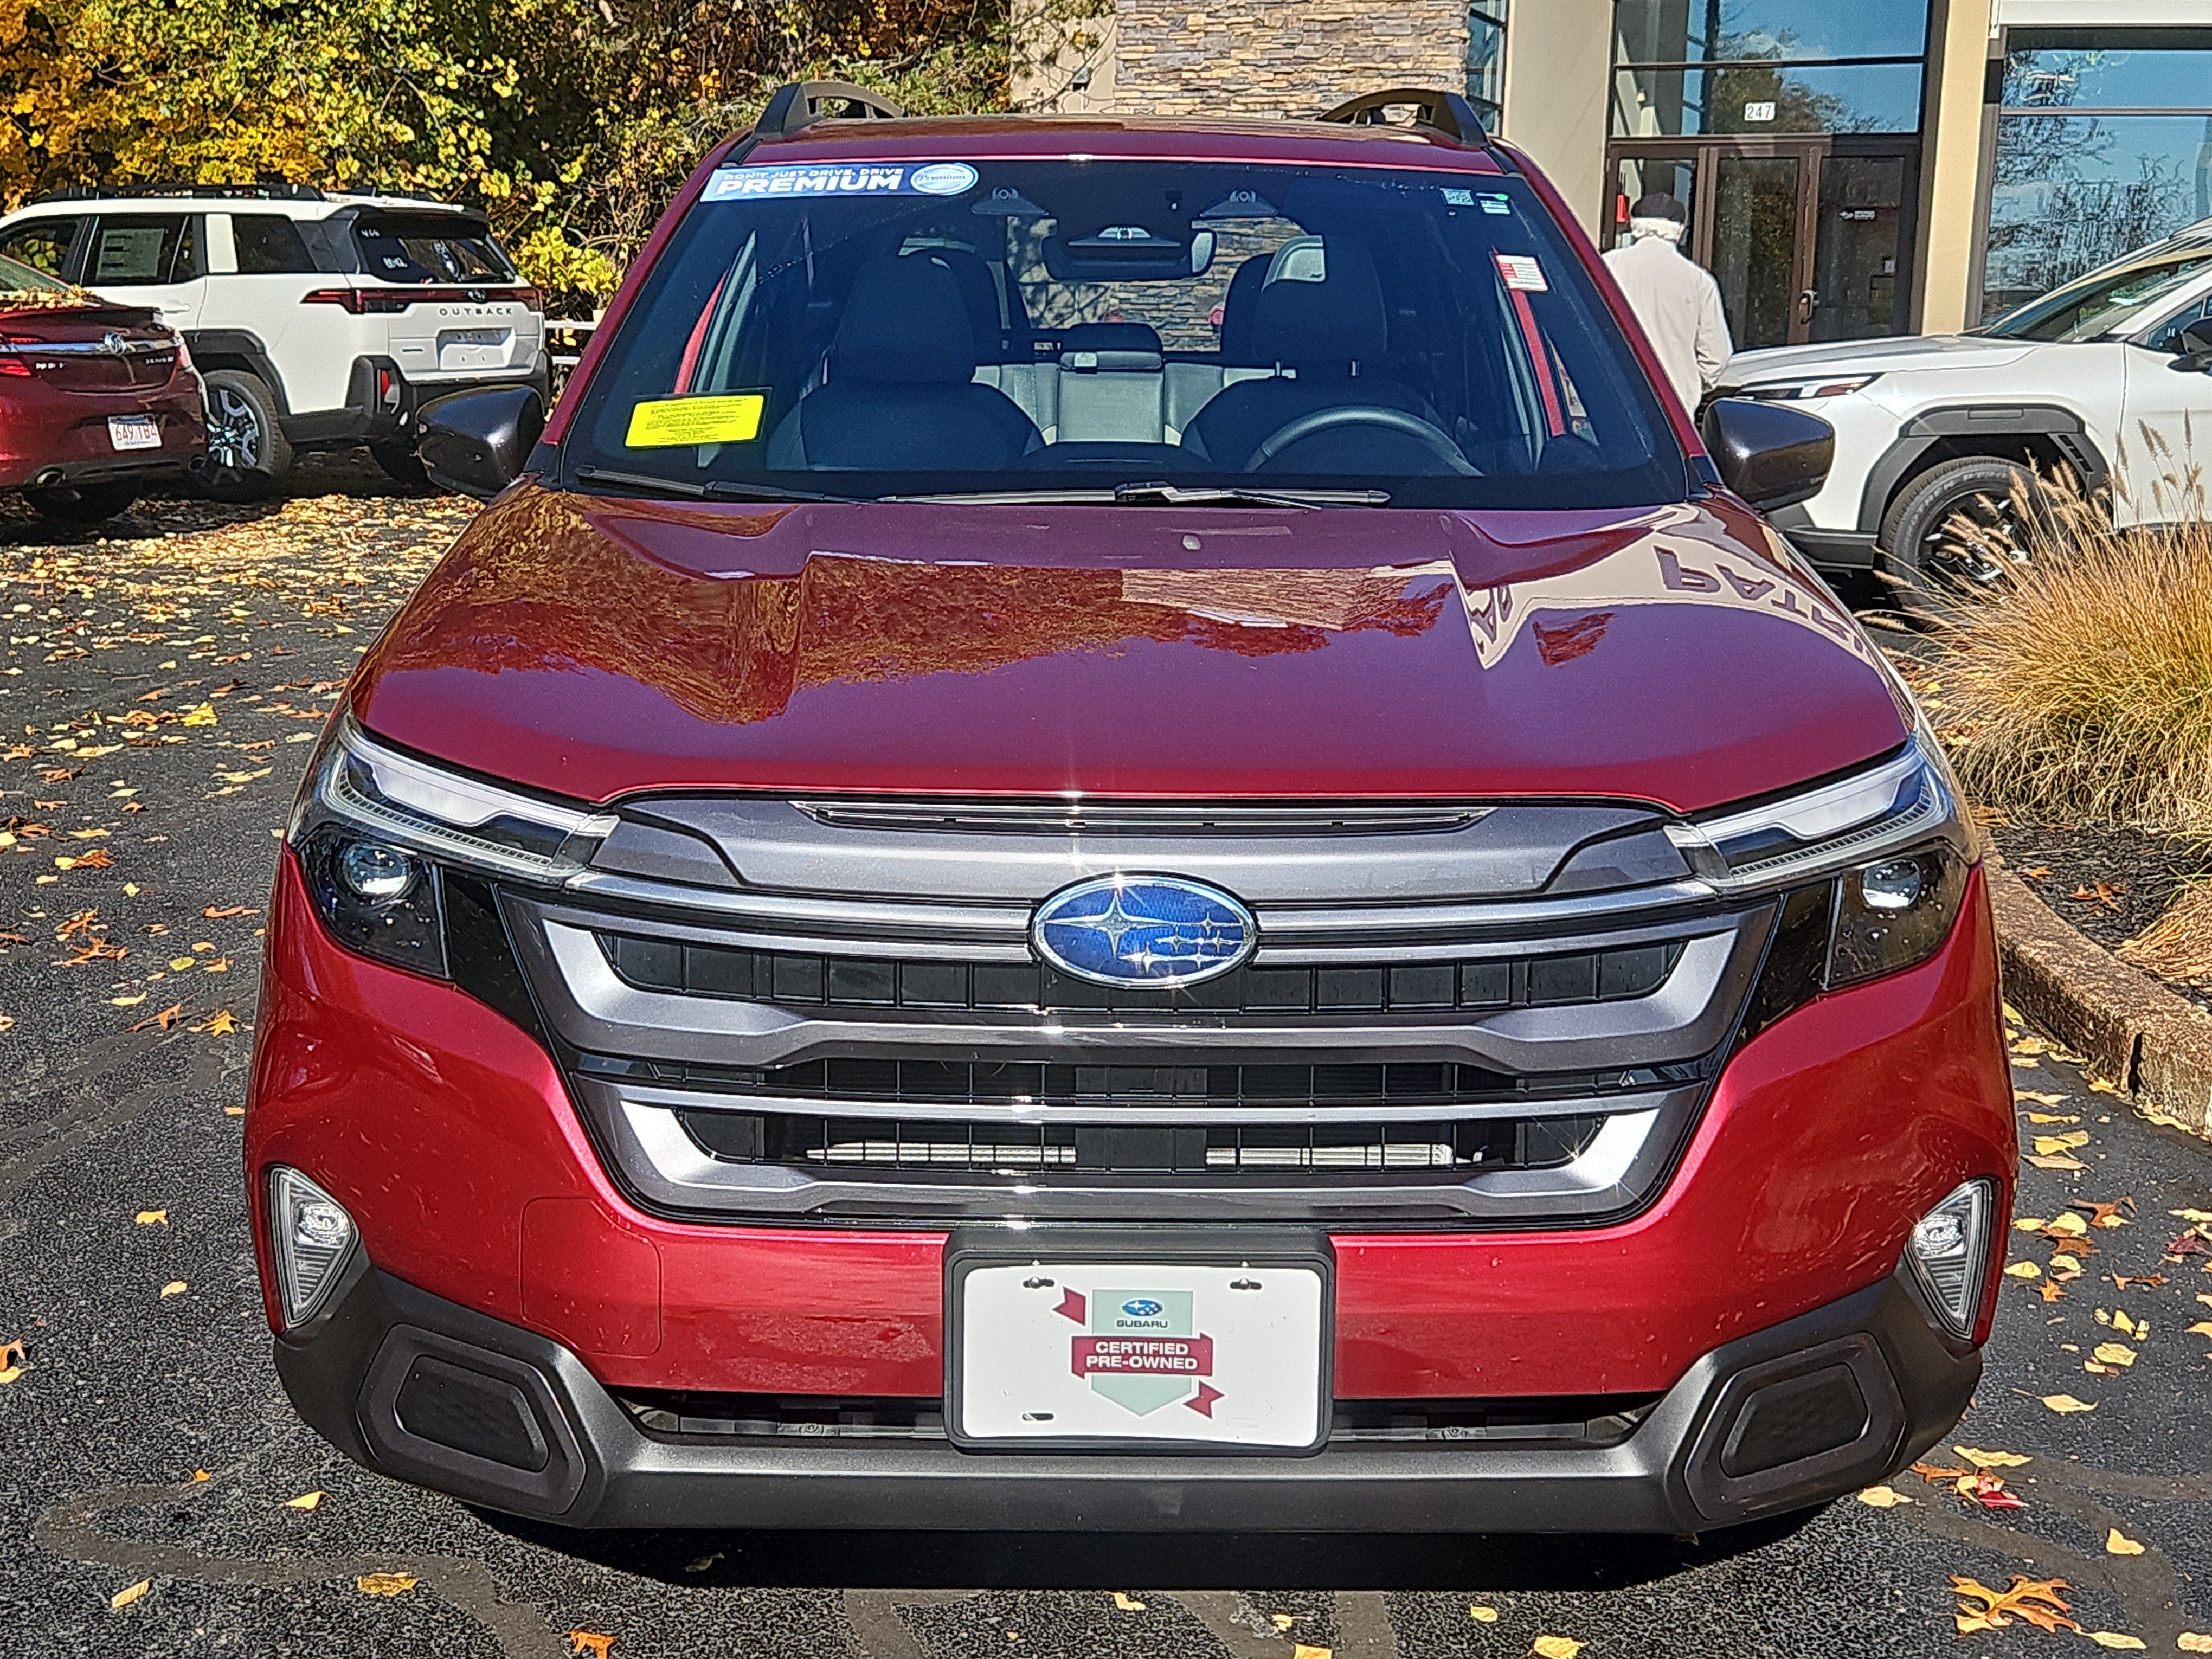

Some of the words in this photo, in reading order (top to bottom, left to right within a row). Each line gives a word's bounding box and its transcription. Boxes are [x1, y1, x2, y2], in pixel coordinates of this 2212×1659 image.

[1747, 105, 1771, 118] 247
[724, 172, 769, 180] DON'T
[716, 175, 902, 195] PREMIUM
[439, 307, 513, 316] OUTBACK
[1116, 1320, 1168, 1328] SUBARU
[1095, 1341, 1189, 1355] CERTIFIED
[1086, 1355, 1198, 1369] PRE-OWNED
